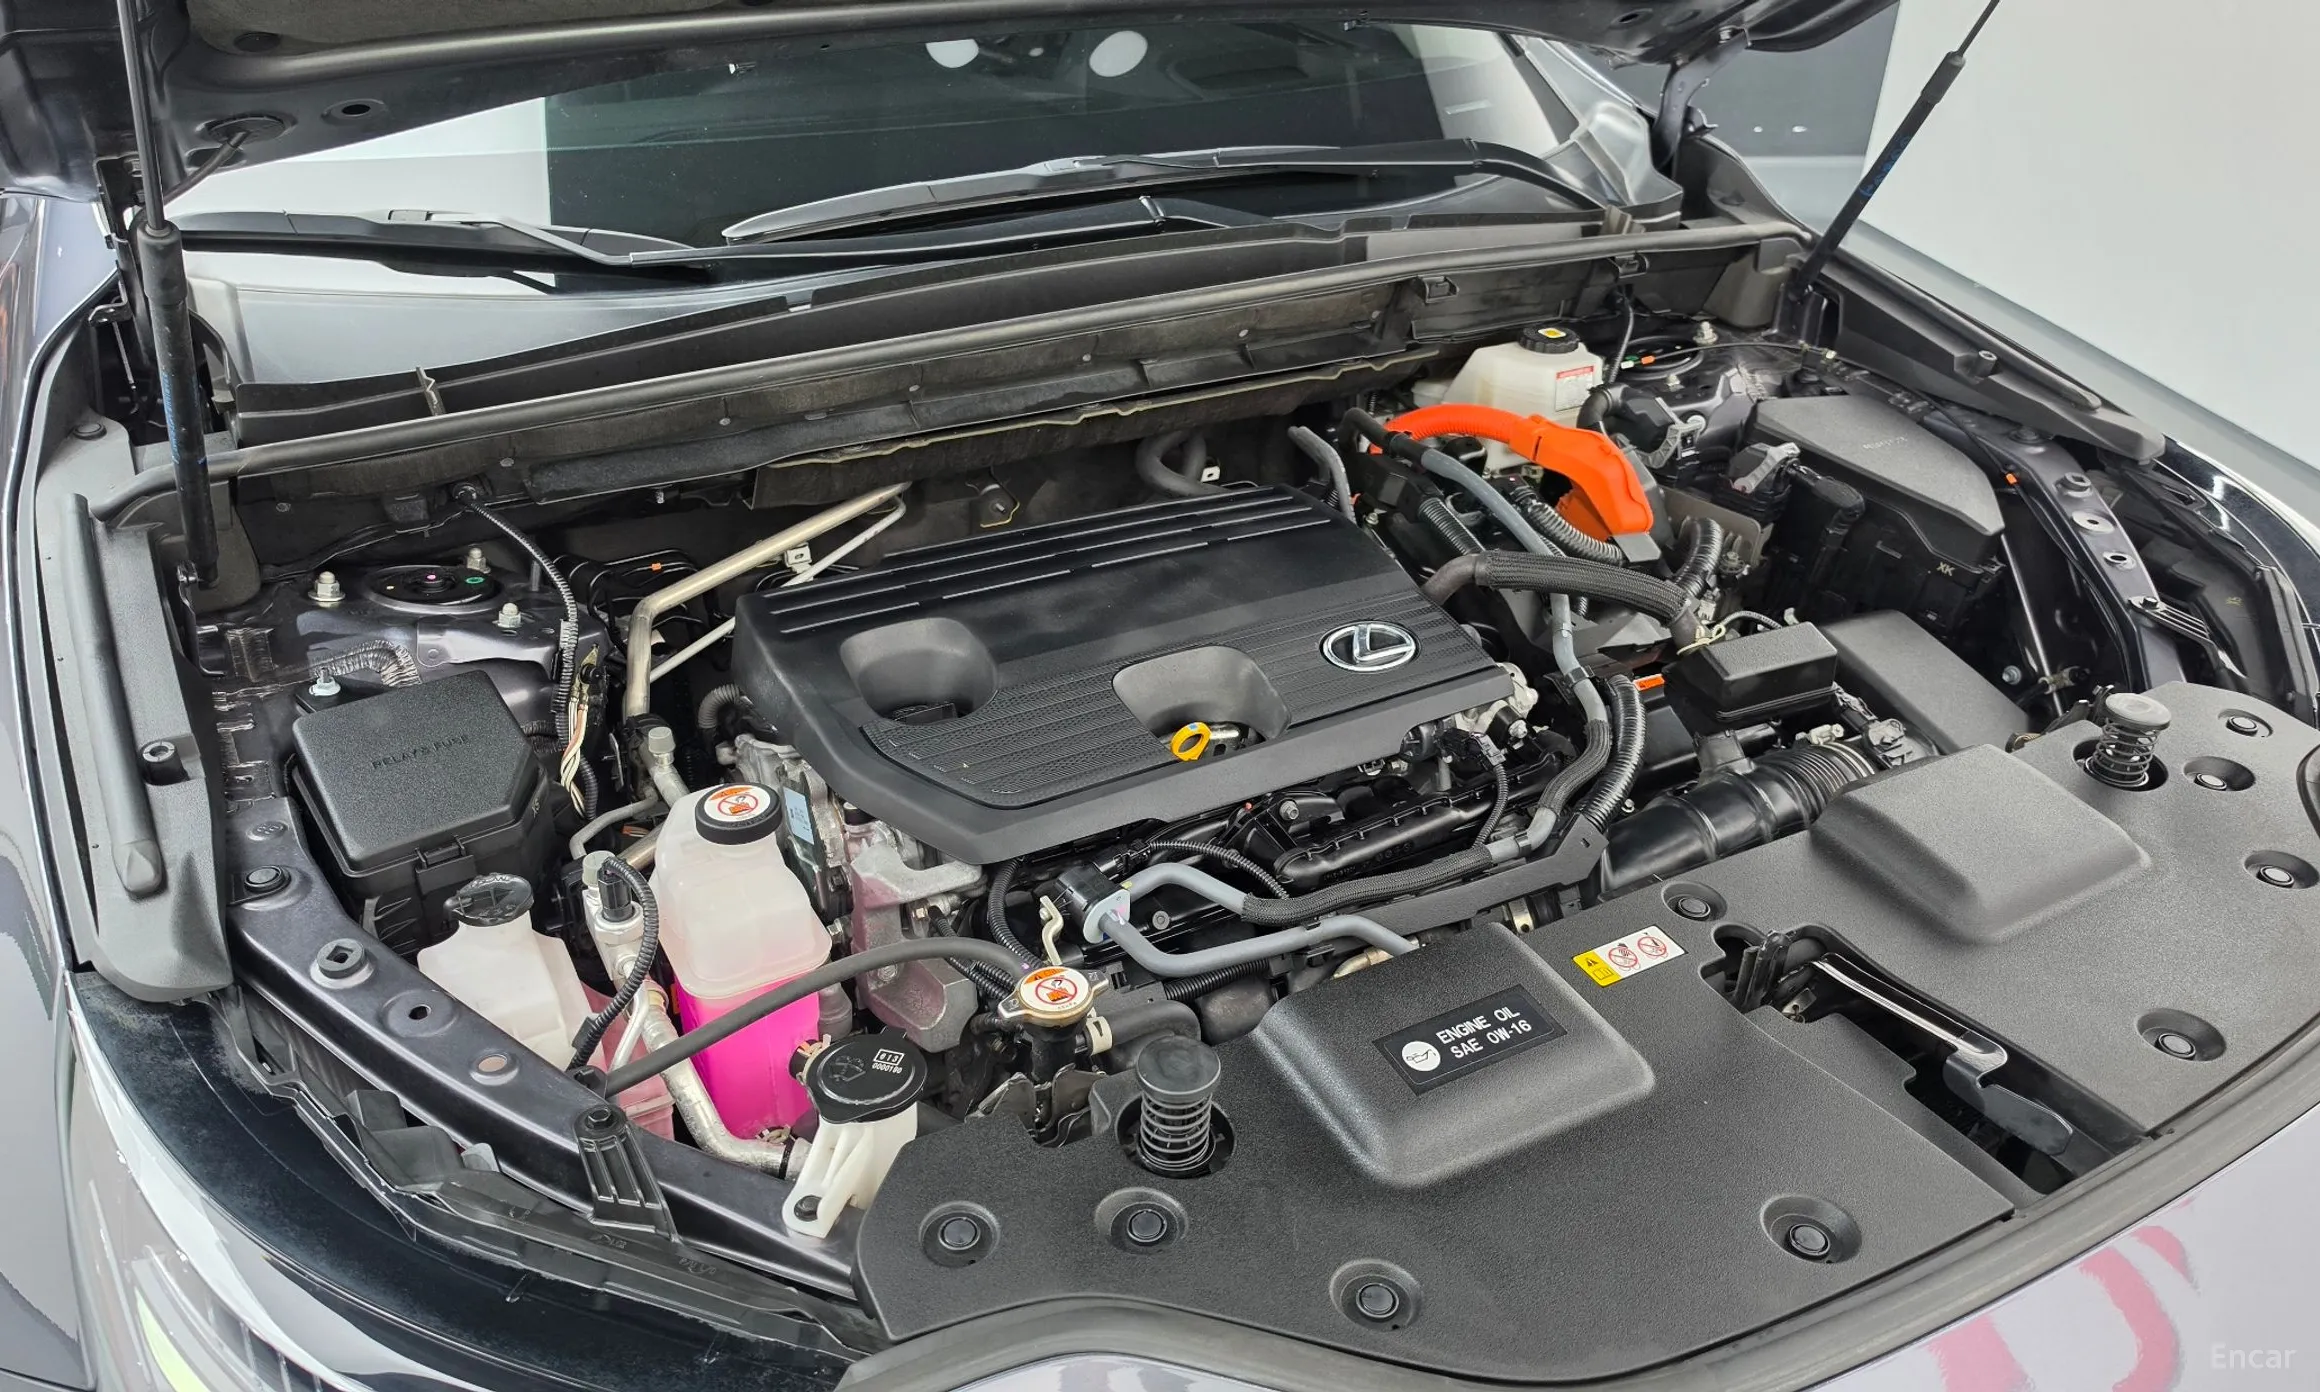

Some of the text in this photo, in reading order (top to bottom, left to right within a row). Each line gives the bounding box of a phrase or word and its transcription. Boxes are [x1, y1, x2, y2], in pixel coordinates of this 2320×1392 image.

[1435, 1006, 1521, 1044] ENGINE OIL
[1450, 1019, 1532, 1059] SAE 0W-16
